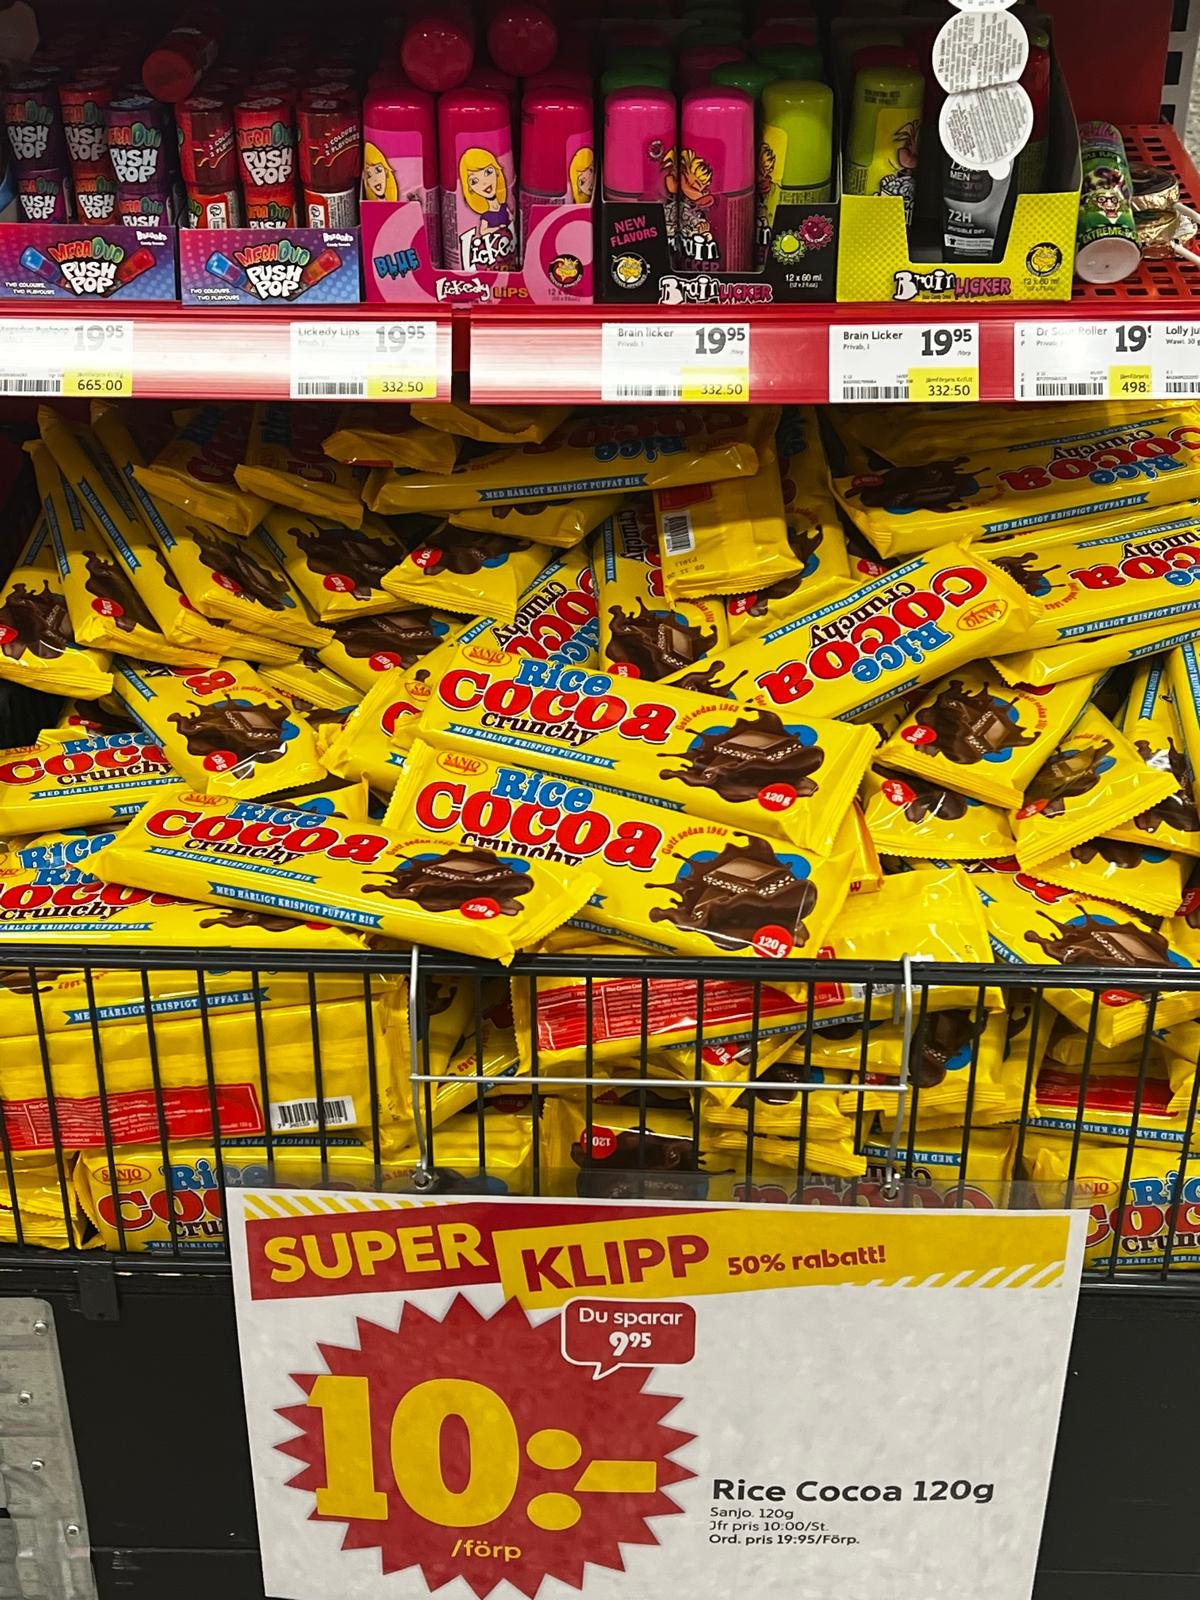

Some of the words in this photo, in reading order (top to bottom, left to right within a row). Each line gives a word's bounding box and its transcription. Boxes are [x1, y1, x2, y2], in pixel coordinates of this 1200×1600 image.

[110, 149, 158, 167] PUSH
[242, 148, 293, 169] PUSH
[116, 166, 156, 183] POP
[250, 166, 292, 186] POP
[950, 171, 971, 182] MEN
[20, 195, 55, 208] PUSH
[78, 194, 115, 207] PUSH
[26, 206, 54, 219] POP
[83, 206, 113, 219] POP
[948, 209, 971, 223] 72H
[614, 215, 647, 234] NEW
[610, 227, 658, 248] FLAVORS
[61, 261, 117, 280] PUSH
[374, 249, 420, 280] BLUE
[247, 265, 303, 284] PUSH
[70, 277, 113, 295] POP
[255, 280, 299, 299] POP
[660, 276, 720, 304] Brain
[893, 269, 955, 300] Brain
[954, 277, 1012, 299] LICKER
[298, 327, 337, 340] Lickedy
[341, 328, 360, 340] Lips
[618, 328, 643, 337] Brain
[843, 331, 869, 340] Brain
[872, 330, 902, 340] Licker
[1079, 327, 1107, 335] Roller
[1115, 325, 1151, 352] 19
[1166, 326, 1188, 338] Lolly
[1088, 455, 1187, 484] Rice
[485, 490, 505, 499] MED
[989, 524, 1009, 533] MED
[1051, 507, 1091, 520] KRISPIGT
[1093, 500, 1125, 512] PUFFAT
[1127, 496, 1142, 504] RIS
[900, 561, 920, 574] MED
[965, 602, 1001, 628] SANJO
[1065, 625, 1085, 636] MED
[1127, 610, 1168, 623] KRISPIGT
[755, 566, 988, 705] Cocoa
[469, 647, 505, 661] SANJO
[851, 620, 953, 683] Rice
[515, 659, 613, 696] Rice
[439, 669, 676, 742] Cocoa
[692, 704, 717, 718] sedan
[453, 726, 474, 736] MED
[514, 737, 557, 755] KRISPIGT
[559, 747, 592, 762] PUFFAT
[593, 756, 611, 766] RIS
[444, 754, 481, 774] SANJO
[108, 780, 153, 790] KRISPIGT
[491, 767, 593, 813] Rice
[119, 805, 141, 815] MED
[226, 802, 327, 828] Rice
[415, 781, 663, 871] Cocoa
[677, 826, 704, 841] sedan
[145, 809, 390, 864] Cocoa
[17, 832, 116, 869] Rice
[154, 847, 179, 856] MED
[215, 857, 258, 871] KRISPIGT
[259, 866, 294, 878] PUFFAT
[295, 873, 312, 882] RIS
[215, 886, 236, 896] MED
[278, 898, 320, 914] KRISPIGT
[321, 907, 356, 922] PUFFAT
[358, 915, 374, 925] RIS
[39, 923, 86, 931] KRISPIGT
[74, 1012, 90, 1021] ME
[207, 993, 240, 1005] UFFAT
[242, 992, 254, 1001] RI
[930, 1153, 954, 1164] MED
[264, 1223, 490, 1284] SUPER
[521, 1235, 709, 1293] KLIPP
[728, 1253, 786, 1277] 50%
[791, 1244, 887, 1271] rabatt!
[578, 1307, 607, 1325] Du
[612, 1309, 683, 1327] sparar
[712, 1478, 786, 1502] Rice
[796, 1480, 903, 1502] Cocoa
[912, 1480, 995, 1504] 120g
[710, 1507, 755, 1520] Sanjo.
[758, 1507, 795, 1520] 120g
[709, 1520, 730, 1532] Jfr
[732, 1520, 760, 1533] pris
[763, 1520, 829, 1532] 10:00/St.
[709, 1533, 742, 1545] Ord.
[745, 1533, 774, 1546] pris
[776, 1533, 861, 1546] 19:95/Förp.
[451, 1539, 522, 1561] /förp
